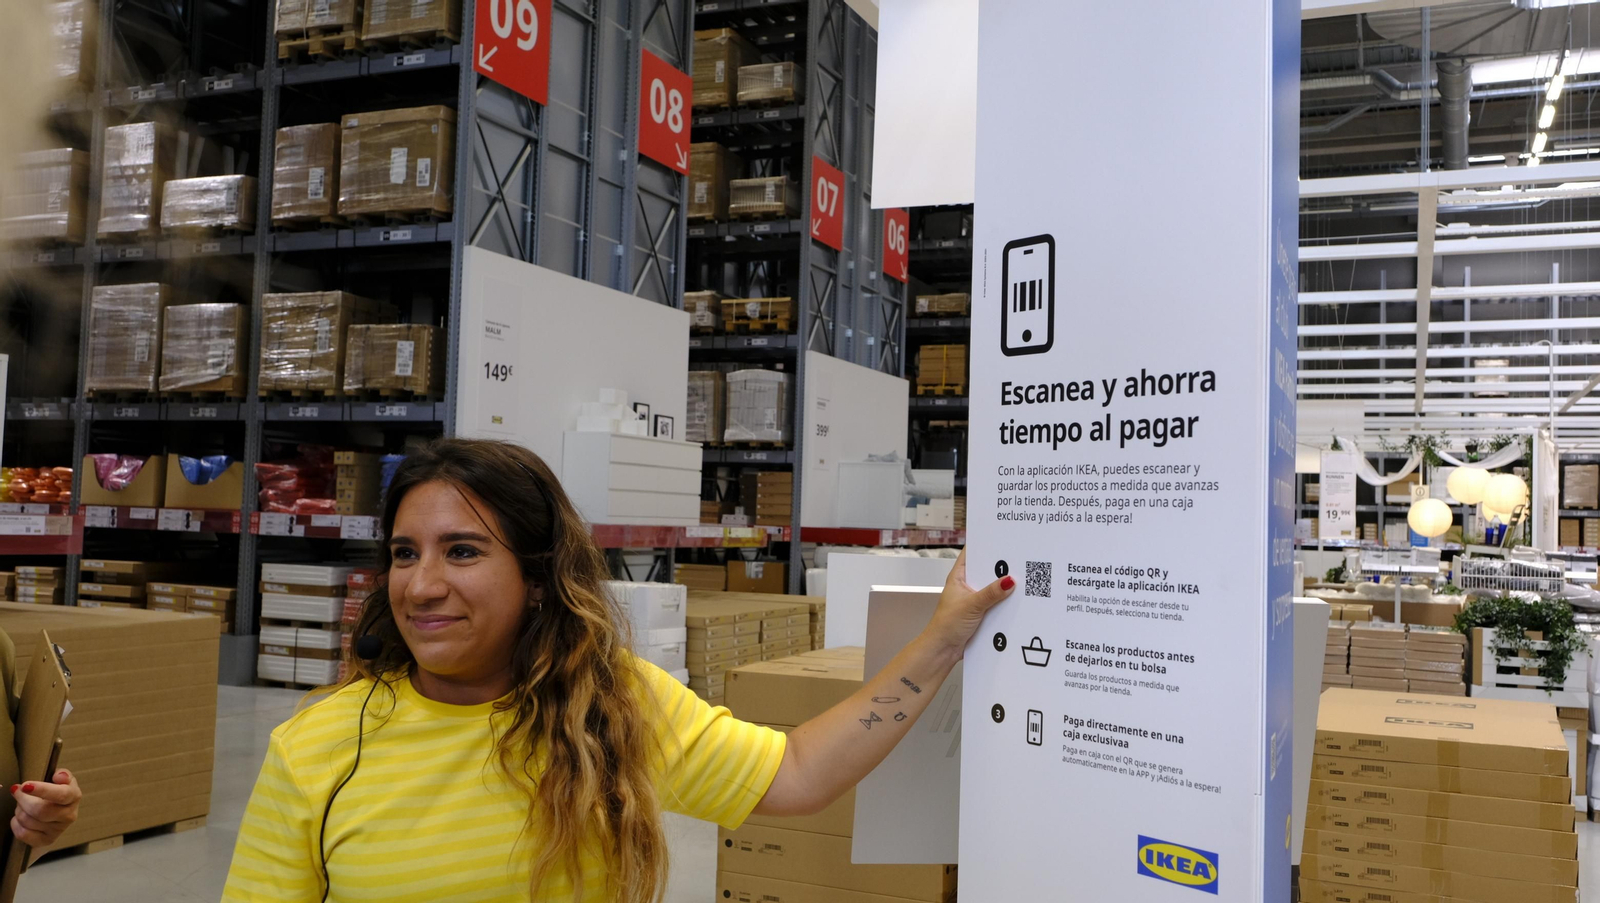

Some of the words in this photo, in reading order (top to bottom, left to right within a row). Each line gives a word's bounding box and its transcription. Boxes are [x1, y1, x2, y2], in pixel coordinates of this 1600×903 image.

[490, 0, 538, 51] 09
[650, 78, 684, 134] 08
[817, 176, 838, 217] 07
[888, 218, 905, 255] 06
[484, 361, 513, 382] 149€
[1002, 380, 1094, 405] Escanea
[1102, 378, 1117, 407] y
[1124, 368, 1215, 397] ahorra
[999, 419, 1082, 450] tiempo
[1090, 414, 1110, 441] al
[1120, 416, 1199, 448] pagar
[998, 466, 1014, 476] Con
[1018, 465, 1024, 476] la
[1027, 464, 1073, 478] aplicación
[1076, 464, 1100, 476] IKEA,
[1103, 464, 1140, 477] puedes
[1143, 465, 1191, 474] escanear
[1194, 465, 1200, 477] y
[998, 480, 1033, 493] guardar
[1035, 480, 1048, 490] los
[1051, 480, 1098, 493] productos
[1102, 482, 1107, 490] a
[1110, 480, 1148, 490] medida
[1152, 482, 1171, 494] que
[1174, 482, 1219, 490] avanzas
[998, 498, 1012, 508] por
[1015, 495, 1022, 506] la
[1024, 496, 1055, 506] tienda.
[1059, 496, 1102, 509] Después,
[1106, 498, 1130, 510] paga
[1133, 499, 1145, 507] en
[1149, 499, 1168, 507] una
[1172, 496, 1193, 511] caja
[997, 510, 1036, 521] exclusiva
[1038, 514, 1044, 524] y
[1046, 511, 1074, 523] ¡adiós
[1076, 514, 1081, 522] a
[1085, 512, 1092, 522] la
[1096, 513, 1132, 526] espera!
[999, 565, 1004, 573] 1
[1068, 564, 1102, 574] Escanea
[1104, 566, 1112, 574] el
[1115, 566, 1144, 578] código
[1147, 568, 1160, 579] QR
[1163, 571, 1168, 580] y
[1068, 576, 1115, 590] descárgate
[1118, 580, 1125, 589] la
[1128, 581, 1174, 592] aplicación
[1178, 584, 1199, 594] IKEA
[1067, 594, 1090, 602] Habilita
[1099, 597, 1120, 606] opción
[1132, 600, 1158, 608] escáner
[1159, 601, 1180, 610] desde
[1086, 606, 1114, 615] Después,
[1116, 609, 1150, 618] selecciona
[1160, 612, 1184, 621] tienda.
[998, 638, 1002, 646] 2
[1066, 640, 1100, 652] Escanea
[1103, 644, 1115, 654] los
[1118, 647, 1164, 659] productos
[1167, 653, 1194, 663] antes
[1066, 653, 1075, 662] de
[1078, 654, 1112, 667] dejarlos
[1129, 662, 1138, 670] tu
[1142, 662, 1166, 674] bolsa
[1064, 681, 1088, 689] avanzas
[1110, 686, 1132, 696] tienda.
[1065, 670, 1087, 679] Guarda
[1088, 672, 1098, 681] los
[1099, 676, 1132, 685] productos
[1139, 681, 1164, 690] medida
[996, 710, 1001, 718] 3
[1063, 730, 1080, 741] caja
[1083, 734, 1128, 748] exclusivaa
[1064, 715, 1084, 728] Paga
[1087, 719, 1148, 740] directamente
[1151, 732, 1162, 740] en
[1166, 734, 1183, 744] una
[1063, 745, 1078, 755] Paga
[1088, 751, 1101, 760] caja
[1123, 756, 1133, 765] QR
[1134, 760, 1147, 768] que
[1158, 765, 1183, 775] genera
[1062, 754, 1118, 772] automaticamente
[1129, 768, 1134, 776] la
[1157, 774, 1178, 785] ¡Adiós
[1186, 779, 1192, 788] la
[1194, 783, 1221, 793] espera!
[1145, 848, 1212, 880] IKEA
